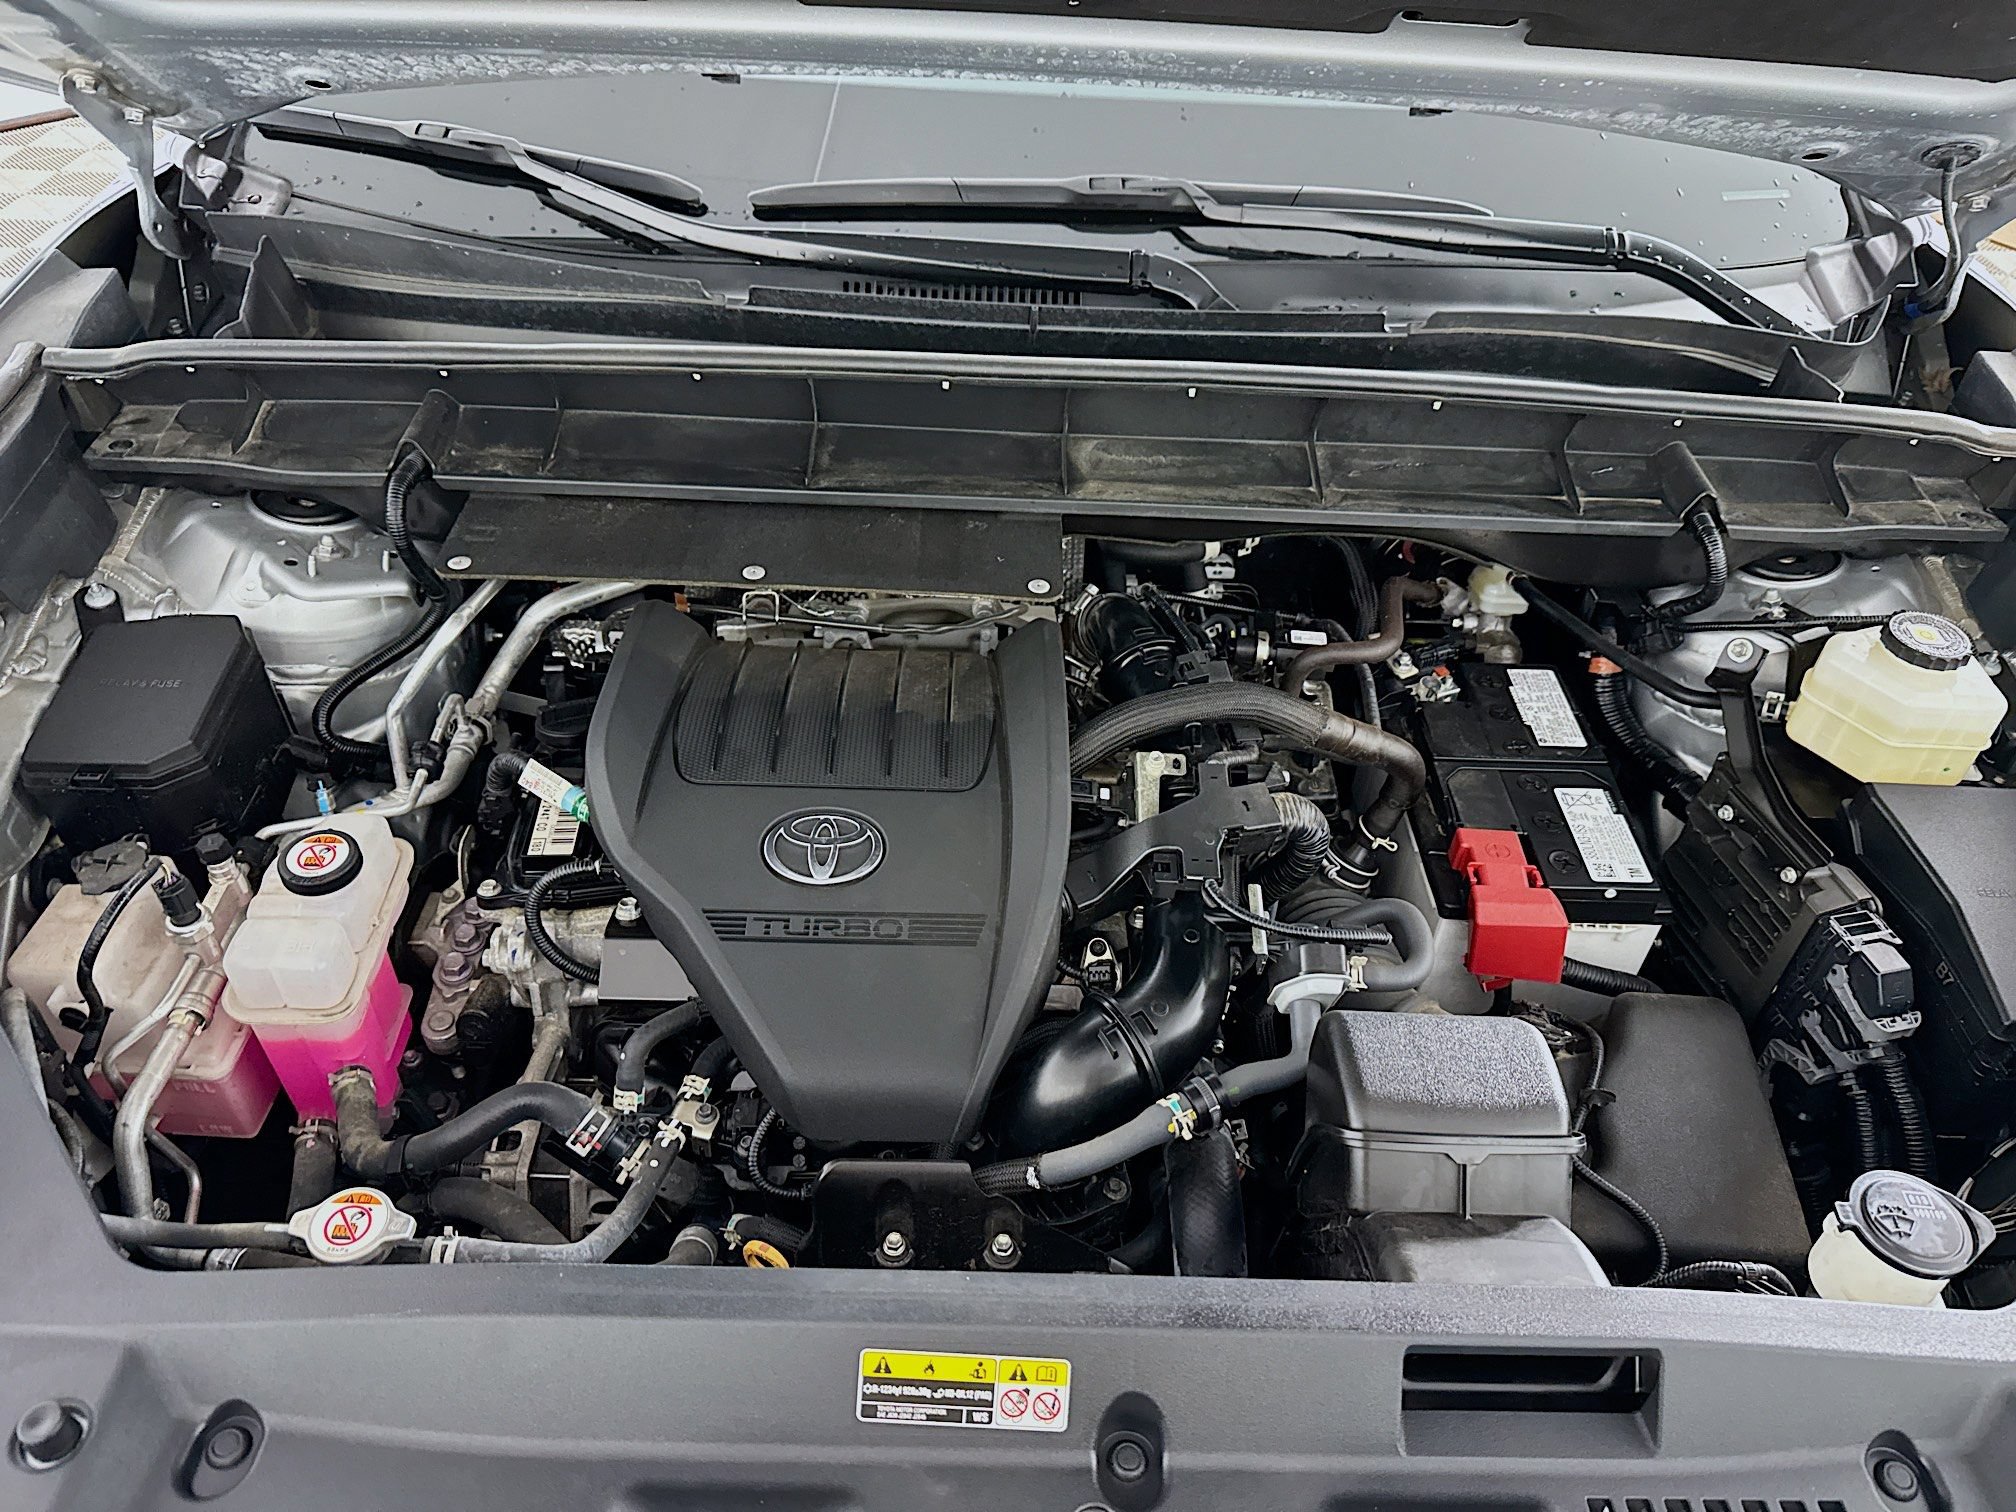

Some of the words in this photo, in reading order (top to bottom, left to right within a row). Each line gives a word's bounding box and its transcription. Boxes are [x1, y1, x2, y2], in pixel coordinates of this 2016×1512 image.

[150, 678, 182, 687] FUSE
[752, 917, 904, 938] TURBO
[1935, 961, 1955, 986] B7
[972, 1410, 989, 1424] WS
